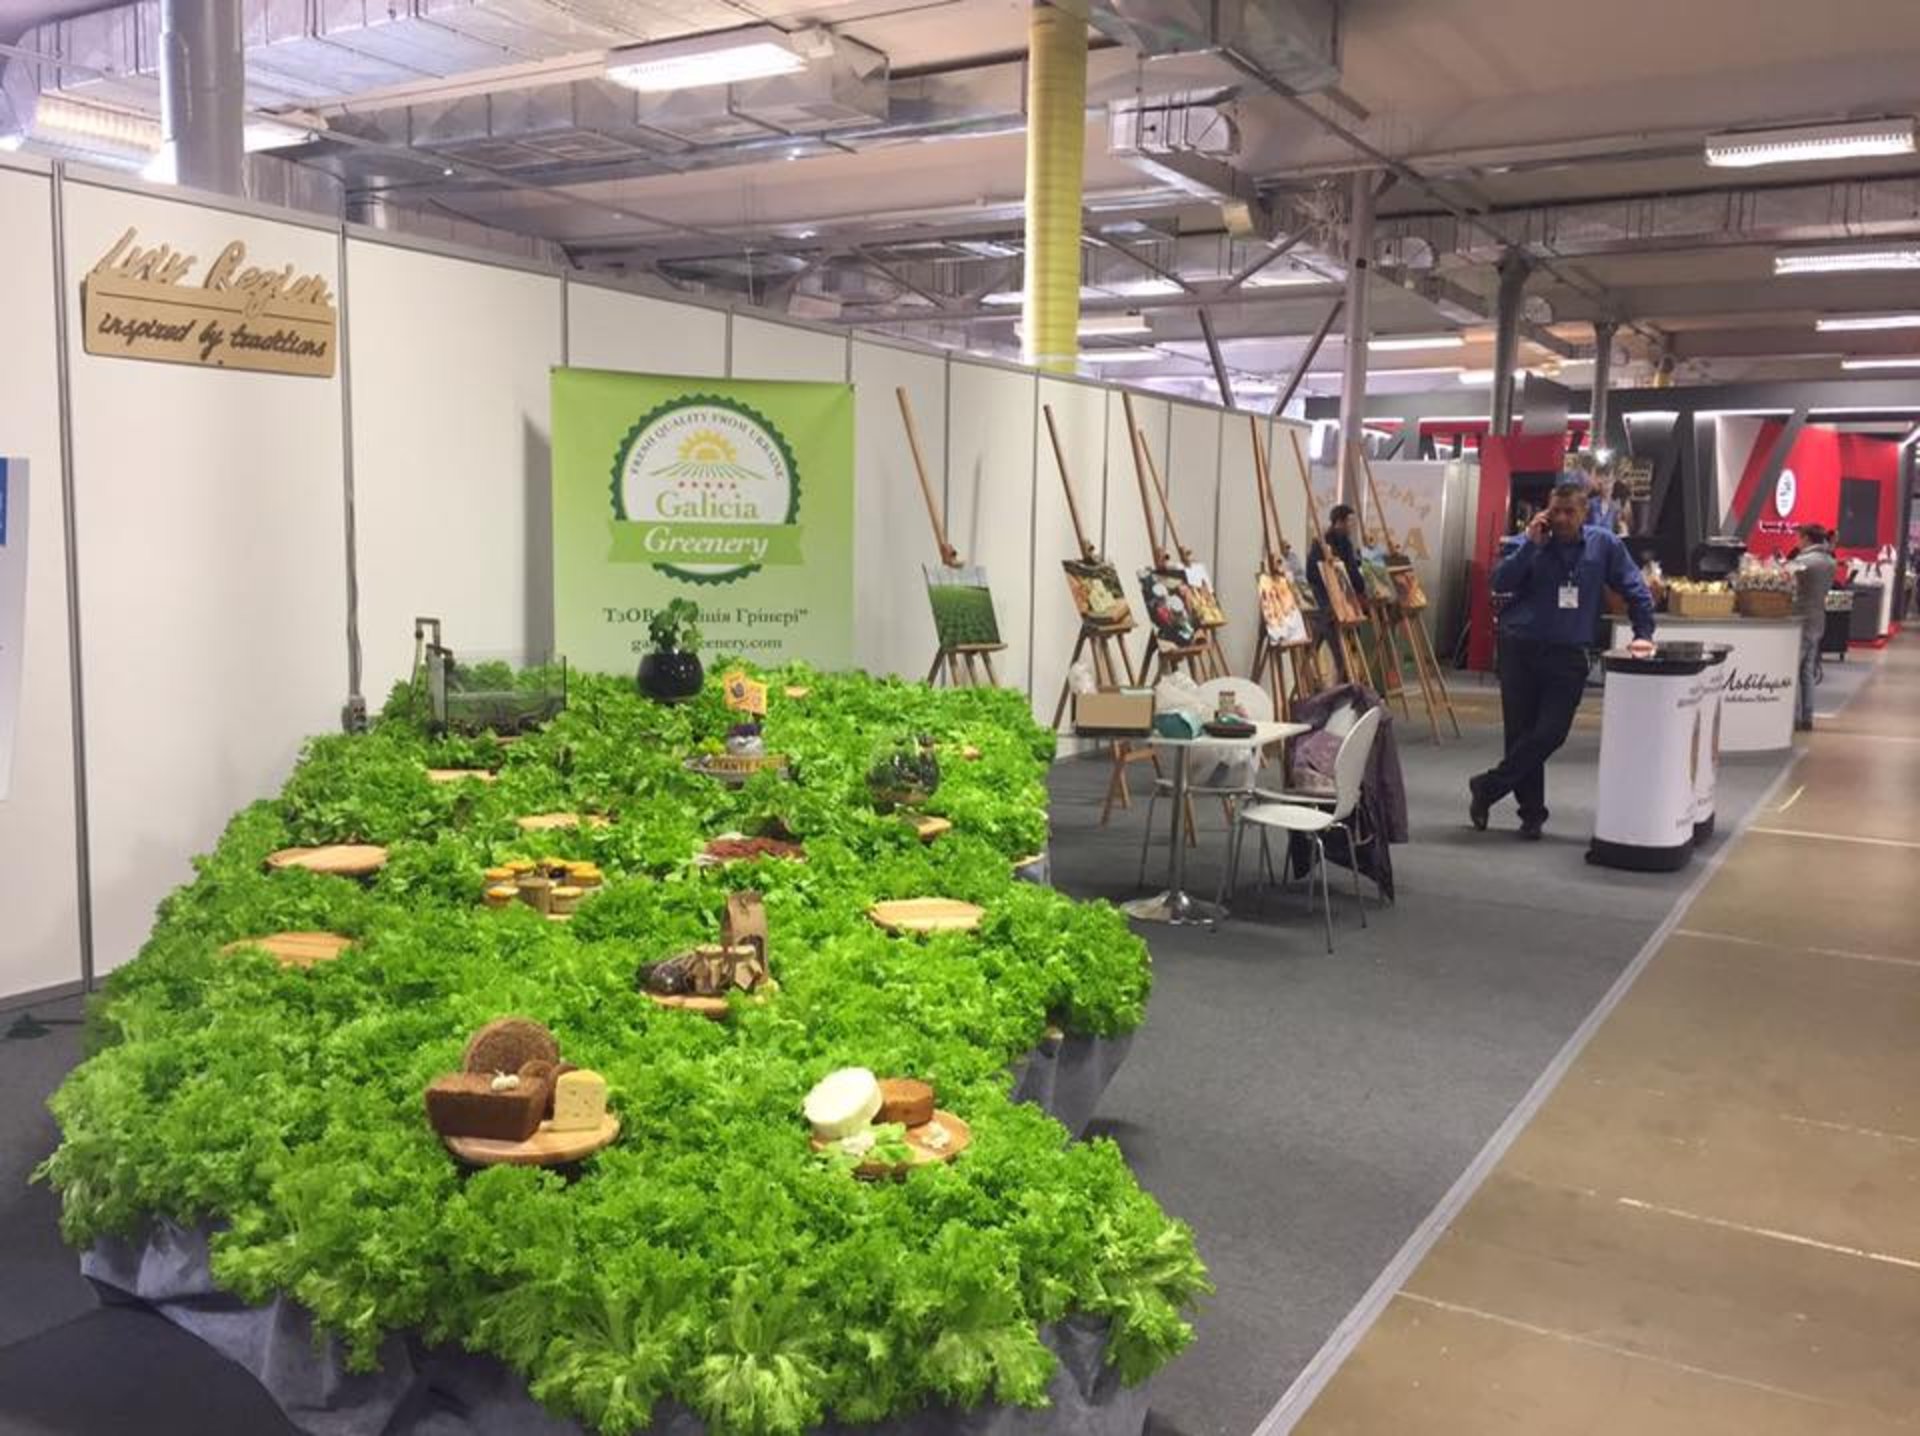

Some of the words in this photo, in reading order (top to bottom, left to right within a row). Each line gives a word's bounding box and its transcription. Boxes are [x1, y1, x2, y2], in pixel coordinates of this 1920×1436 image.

[93, 226, 197, 285] Lviv
[203, 240, 334, 319] Region
[98, 313, 196, 345] inspired
[199, 319, 223, 361] by
[230, 324, 326, 358] traditions
[630, 437, 656, 475] FRESH
[655, 412, 707, 439] QUALITY
[711, 412, 748, 433] FROM
[748, 429, 784, 480] UKRAINE
[655, 491, 759, 519] Galicia
[644, 526, 769, 560] Greenery
